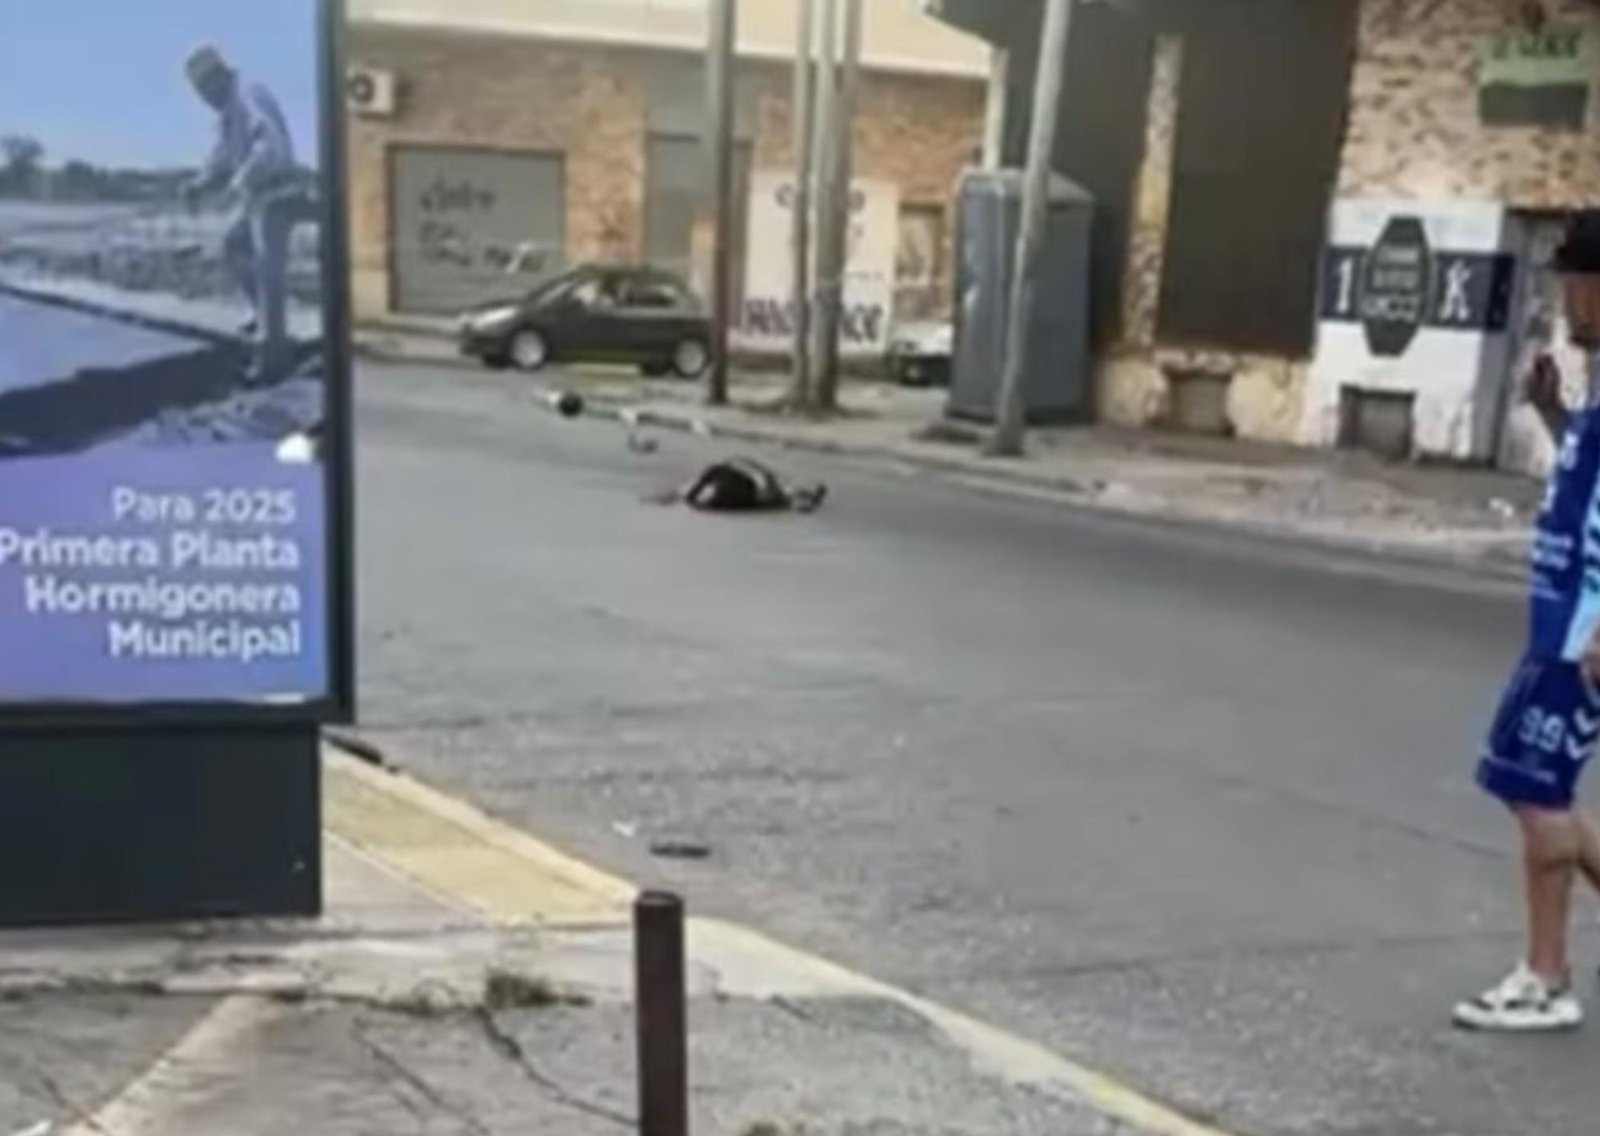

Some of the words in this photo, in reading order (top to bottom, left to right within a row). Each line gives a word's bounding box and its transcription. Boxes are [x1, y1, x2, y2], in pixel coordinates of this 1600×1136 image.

[112, 486, 195, 522] Para
[203, 488, 297, 523] 2025
[0, 527, 160, 567] Primera
[171, 531, 300, 568] Planta
[24, 574, 300, 620] Hormigonera
[107, 619, 300, 662] Municipal
